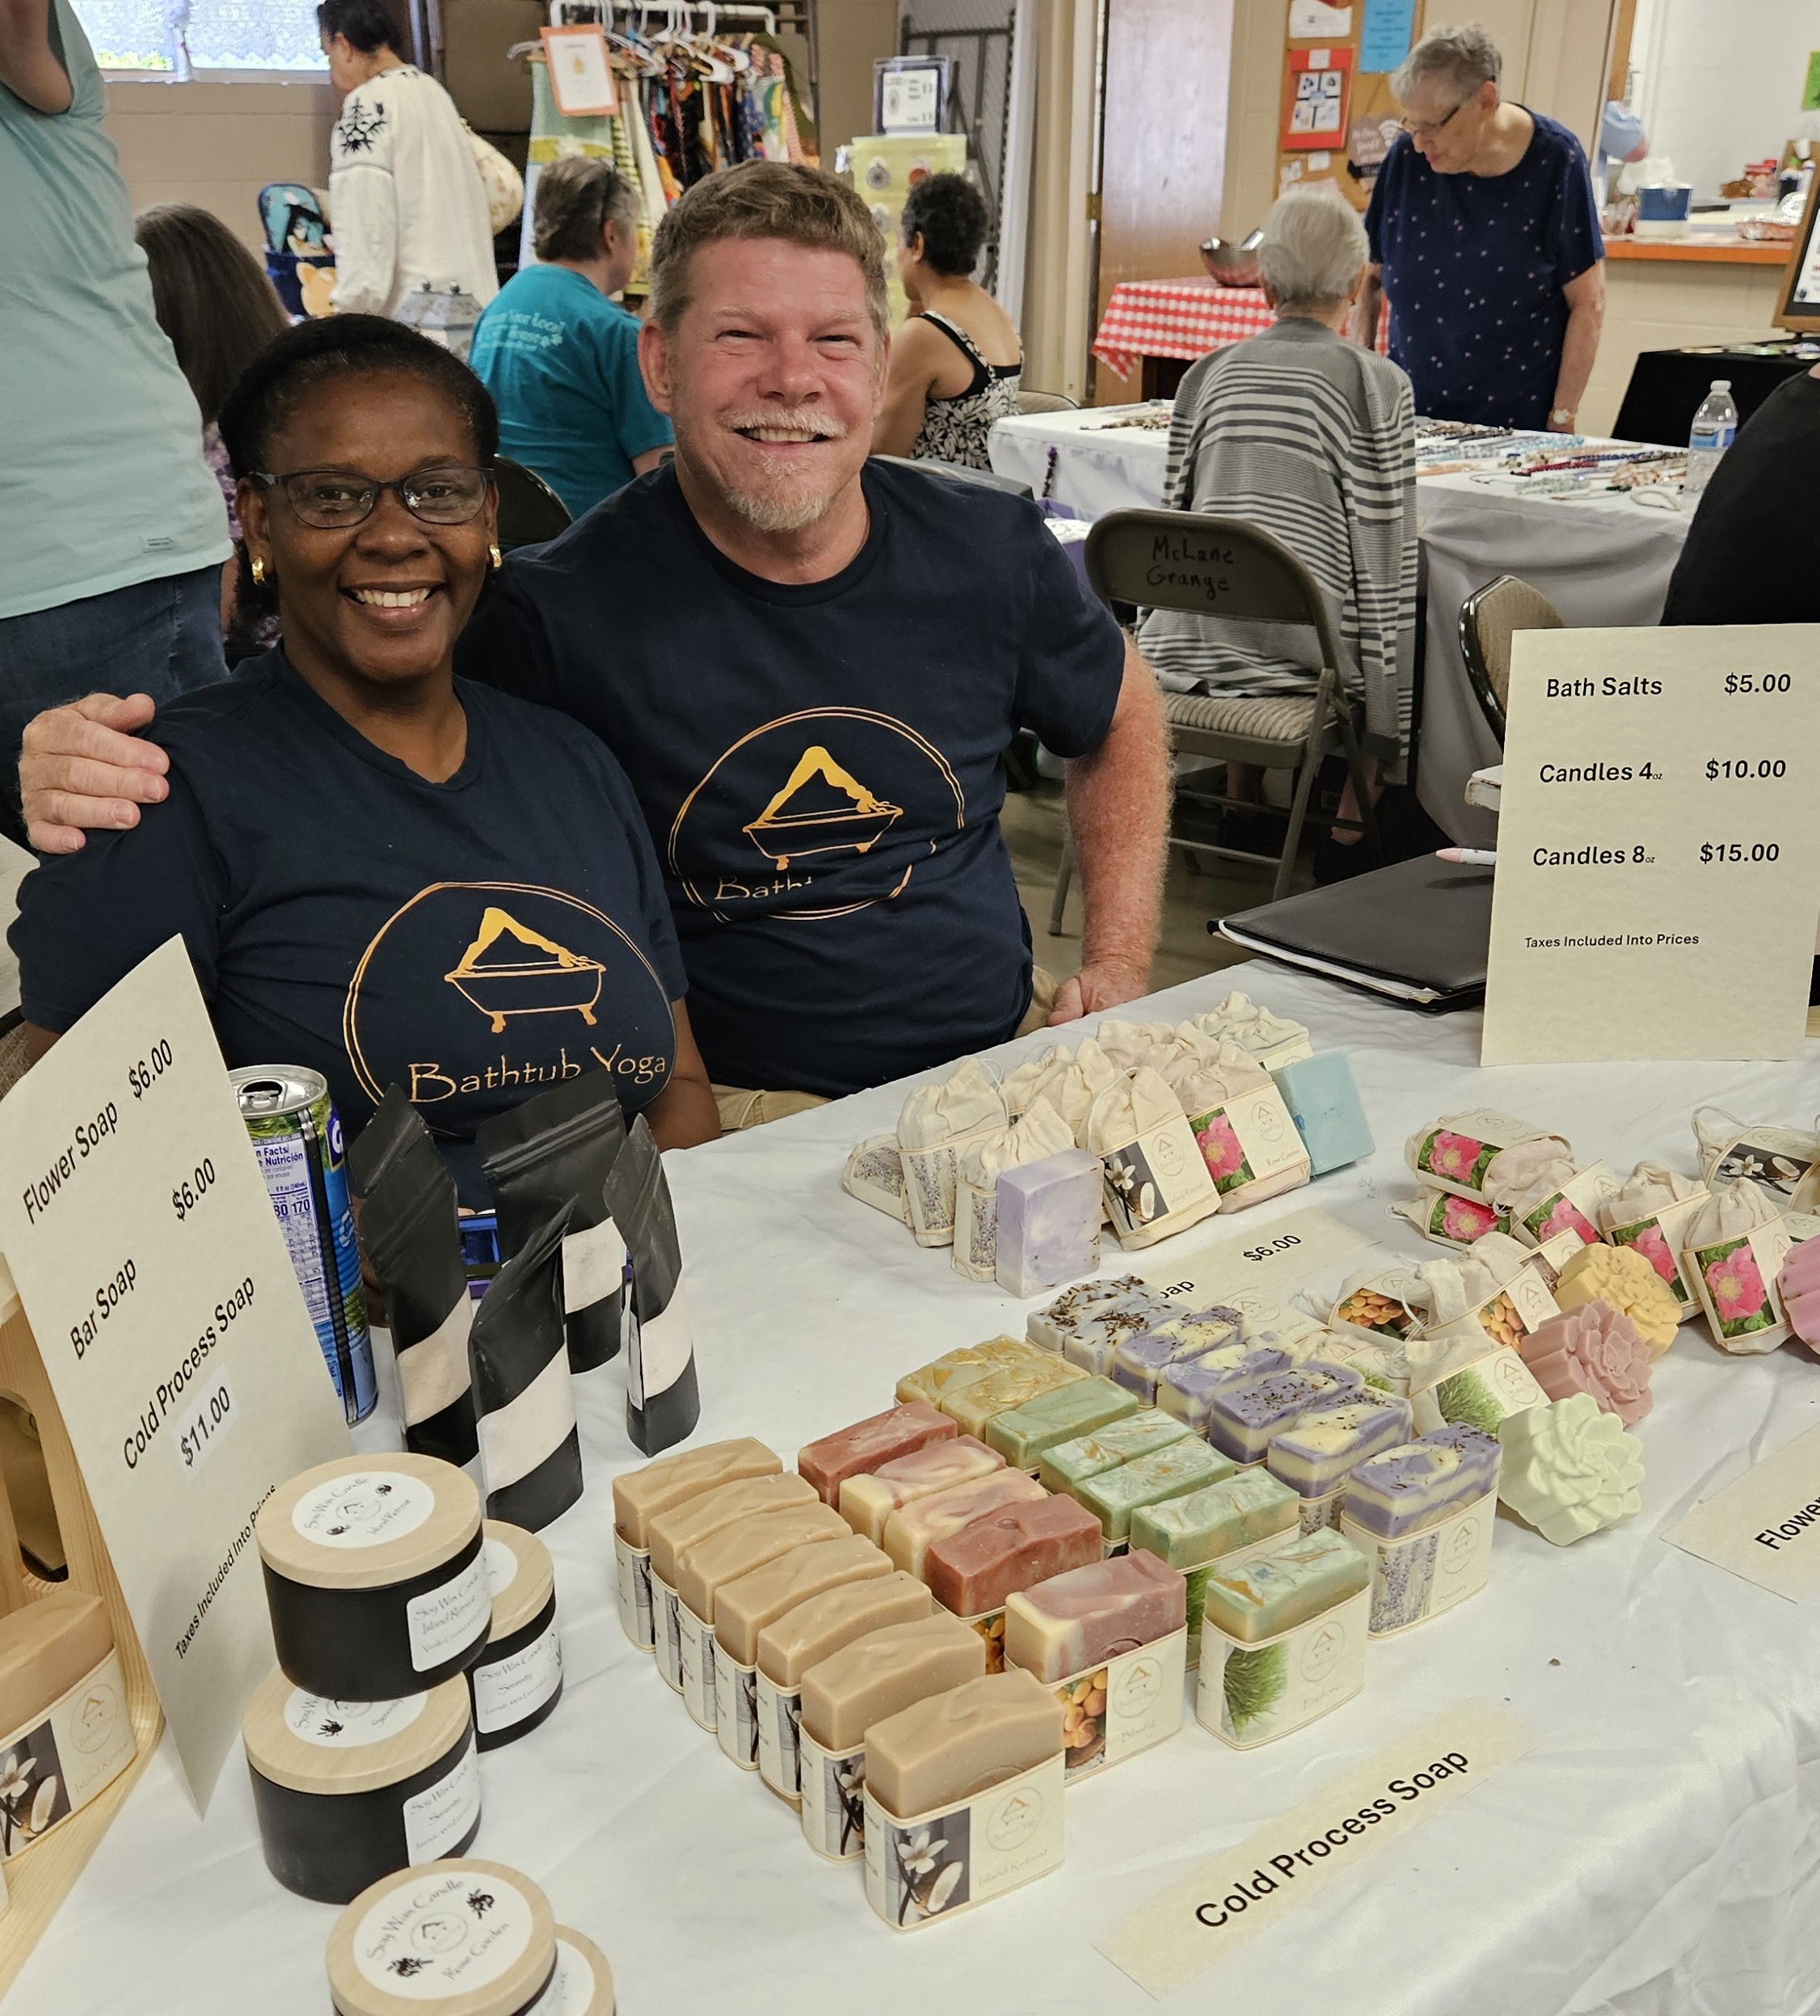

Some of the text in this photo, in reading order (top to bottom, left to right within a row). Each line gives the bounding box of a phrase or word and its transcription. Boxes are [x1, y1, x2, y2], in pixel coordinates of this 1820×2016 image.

[1152, 535, 1234, 564] McLane
[1147, 565, 1229, 600] Grange
[1547, 672, 1791, 698] Bath Salts $5.00
[1540, 762, 1633, 783] Candles
[1705, 757, 1786, 782] $10.00
[1533, 846, 1626, 867] Candles
[1700, 841, 1780, 865] $15.00
[1525, 934, 1700, 948] Taxes Included Into Prices
[408, 1044, 667, 1103] Bathtub Yoga
[23, 1039, 172, 1225] Flower Soap $6.00
[265, 1152, 303, 1166] Nutrición
[172, 1158, 215, 1222] $6.00
[291, 1199, 310, 1213] 170
[1159, 1235, 1301, 1299] oap $6.00
[70, 1259, 136, 1360] Bar Soap
[124, 1277, 255, 1470] Cold Process Soap
[180, 1385, 230, 1466] $11.00
[175, 1614, 200, 1660] Taxes
[199, 1552, 234, 1619] Included
[232, 1525, 251, 1556] Into
[1195, 1752, 1468, 1927] Cold Process Soap
